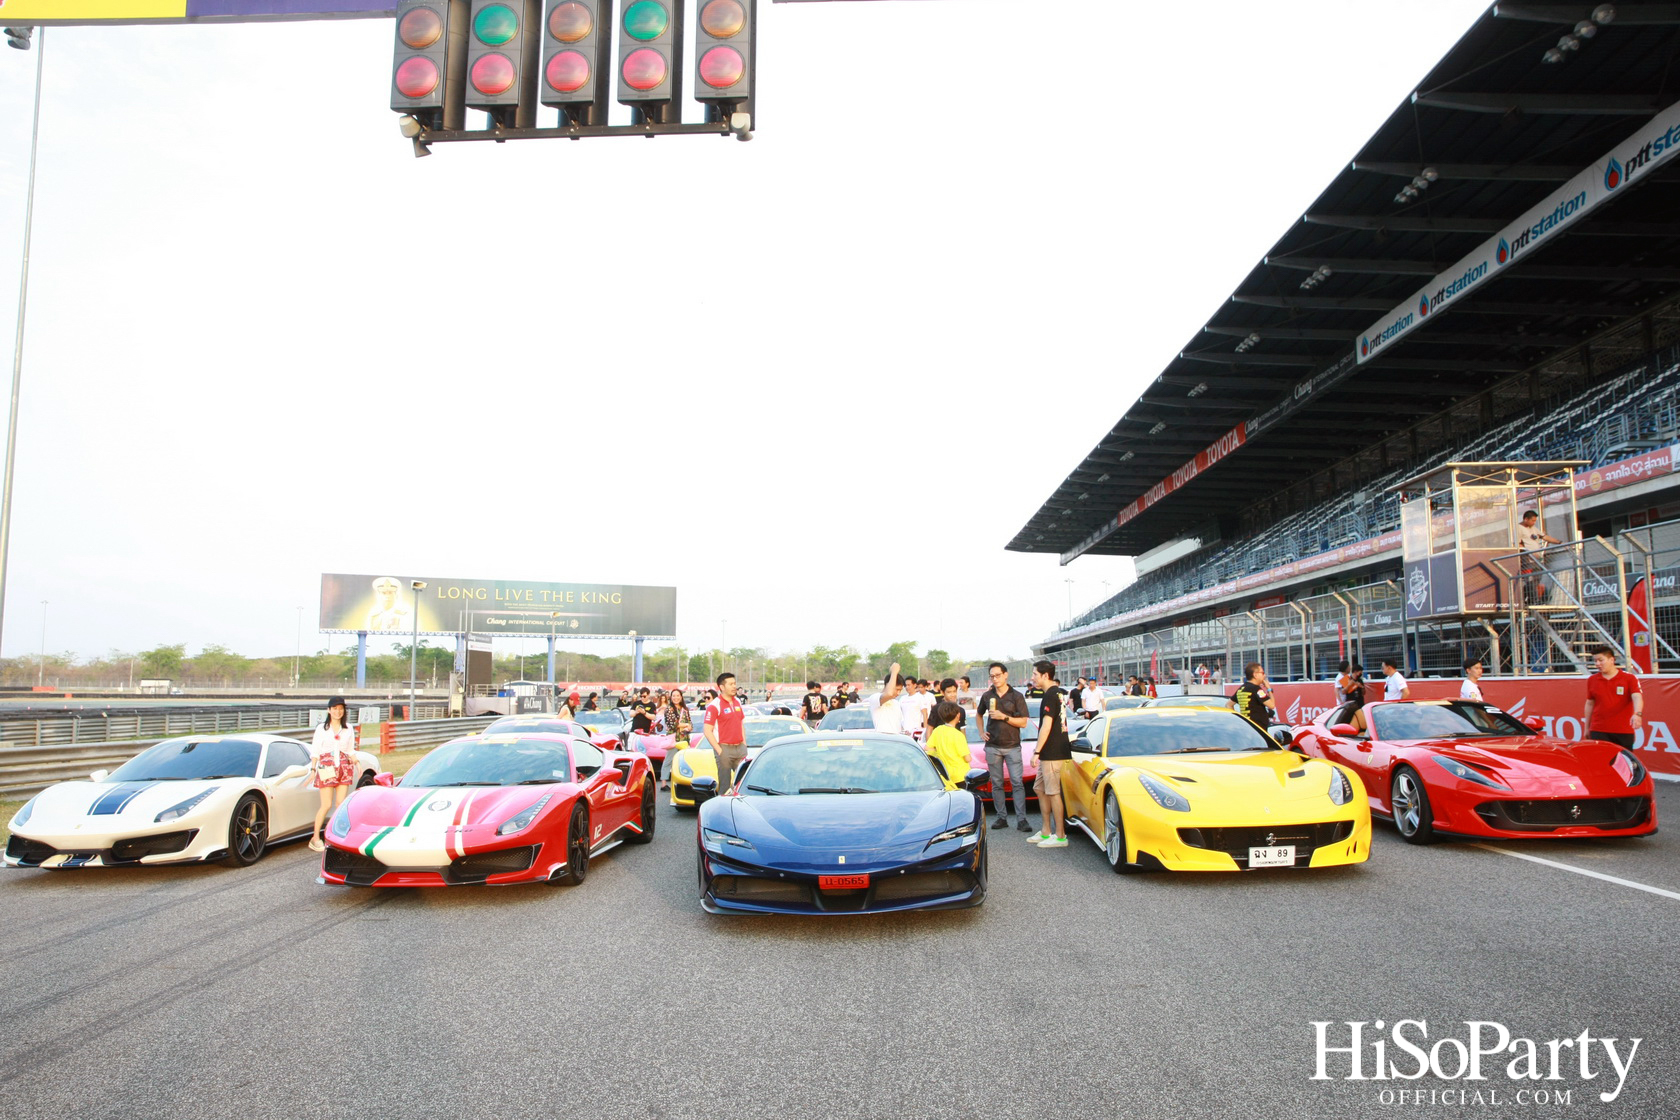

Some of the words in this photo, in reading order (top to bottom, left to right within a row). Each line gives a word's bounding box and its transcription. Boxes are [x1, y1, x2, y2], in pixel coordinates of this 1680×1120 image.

[1206, 428, 1240, 466] TOYOTA
[1172, 458, 1198, 489] TOYOTA
[1144, 481, 1166, 508] TOYOTA
[1119, 500, 1139, 525] TOYOTA
[437, 587, 487, 600] LONG
[495, 588, 534, 601] LIVE
[540, 590, 574, 603] THE
[581, 591, 622, 605] KING
[486, 617, 507, 626] Chang
[1374, 614, 1391, 625] Chang
[529, 697, 542, 711] Chang
[594, 823, 602, 840] 12
[1277, 848, 1288, 858] 89
